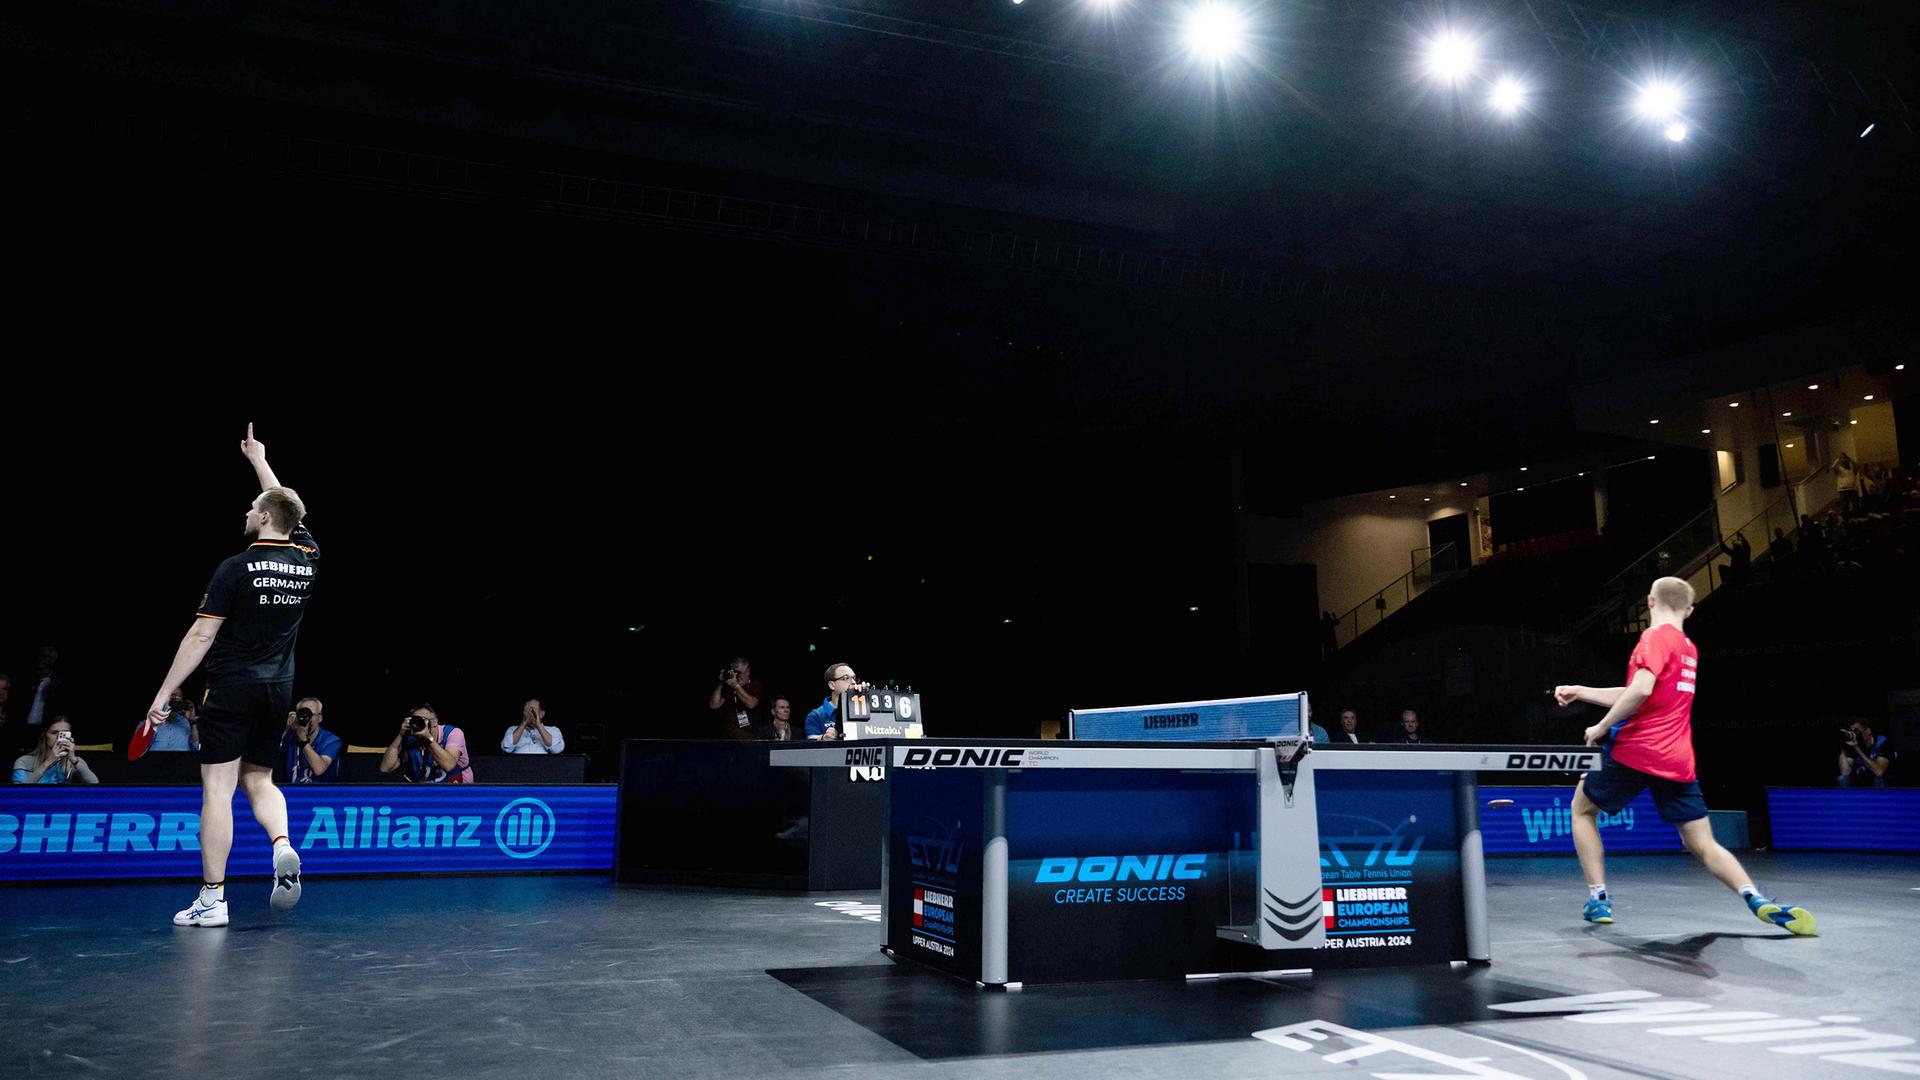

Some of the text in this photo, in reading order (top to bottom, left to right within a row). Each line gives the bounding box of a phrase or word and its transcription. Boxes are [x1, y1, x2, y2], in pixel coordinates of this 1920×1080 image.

[247, 561, 313, 576] LIEBHERR
[253, 578, 310, 590] GERMANY
[259, 595, 270, 604] B.
[850, 694, 912, 718] 11 3 3 6
[1144, 713, 1198, 729] LIEBHERR
[865, 725, 902, 735] Nittaku
[845, 748, 882, 766] DONIC
[903, 749, 1024, 766] DONIC
[1506, 754, 1593, 770] DONIC
[301, 806, 482, 850] Allianz
[1035, 854, 1208, 883] DONIC
[1341, 869, 1361, 879] Table
[1363, 868, 1388, 878] Tennis
[1389, 867, 1413, 878] Union
[1055, 886, 1186, 904] CREATE SUCCESS
[1336, 887, 1408, 902] LIEBHERR
[924, 904, 955, 923] EUROPEAN
[1337, 901, 1409, 916] EUROPEAN
[1338, 916, 1410, 928] CHAMPIONSHIPS
[1345, 937, 1386, 948] AUSTRIA
[1387, 935, 1412, 947] 2024
